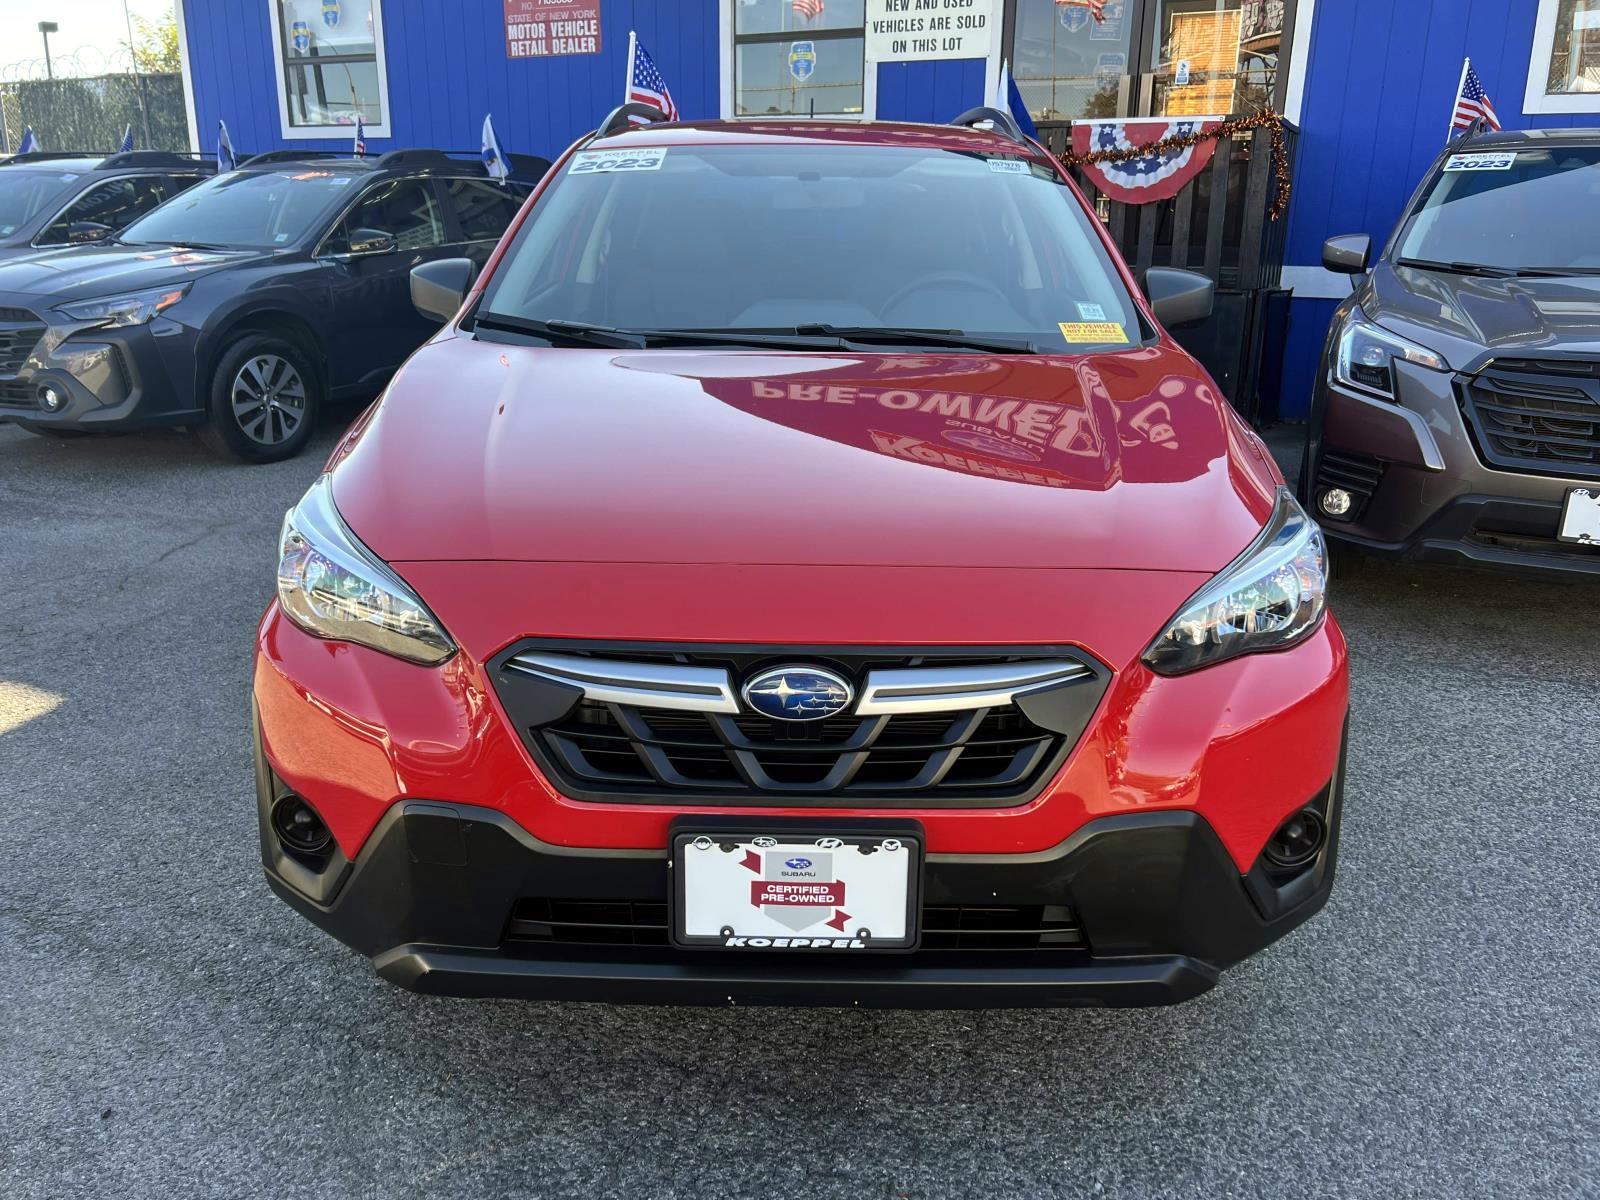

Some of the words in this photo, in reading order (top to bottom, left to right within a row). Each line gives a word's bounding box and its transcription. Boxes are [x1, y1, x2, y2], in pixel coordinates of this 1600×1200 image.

[885, 0, 909, 12] NEW
[915, 0, 938, 10] AND
[943, 0, 973, 9] USED
[508, 14, 532, 23] STATE
[535, 13, 546, 21] OF
[549, 11, 569, 20] NEW
[572, 10, 597, 19] YORK
[508, 23, 546, 40] MOTOR
[551, 20, 598, 37] VEHICLE
[873, 18, 924, 33] VEHICLES
[929, 17, 951, 30] ARE
[957, 15, 985, 29] SOLD
[511, 39, 549, 56] RETAIL
[552, 37, 596, 54] DEALER
[892, 40, 907, 53] ON
[912, 38, 937, 52] THIS
[943, 37, 963, 51] LOT
[573, 158, 660, 171] 2023
[1447, 160, 1511, 169] 2023
[767, 885, 829, 894] CERTIFIED
[761, 893, 835, 903] PRE-OWNED
[725, 937, 865, 949] KOEPPEL
